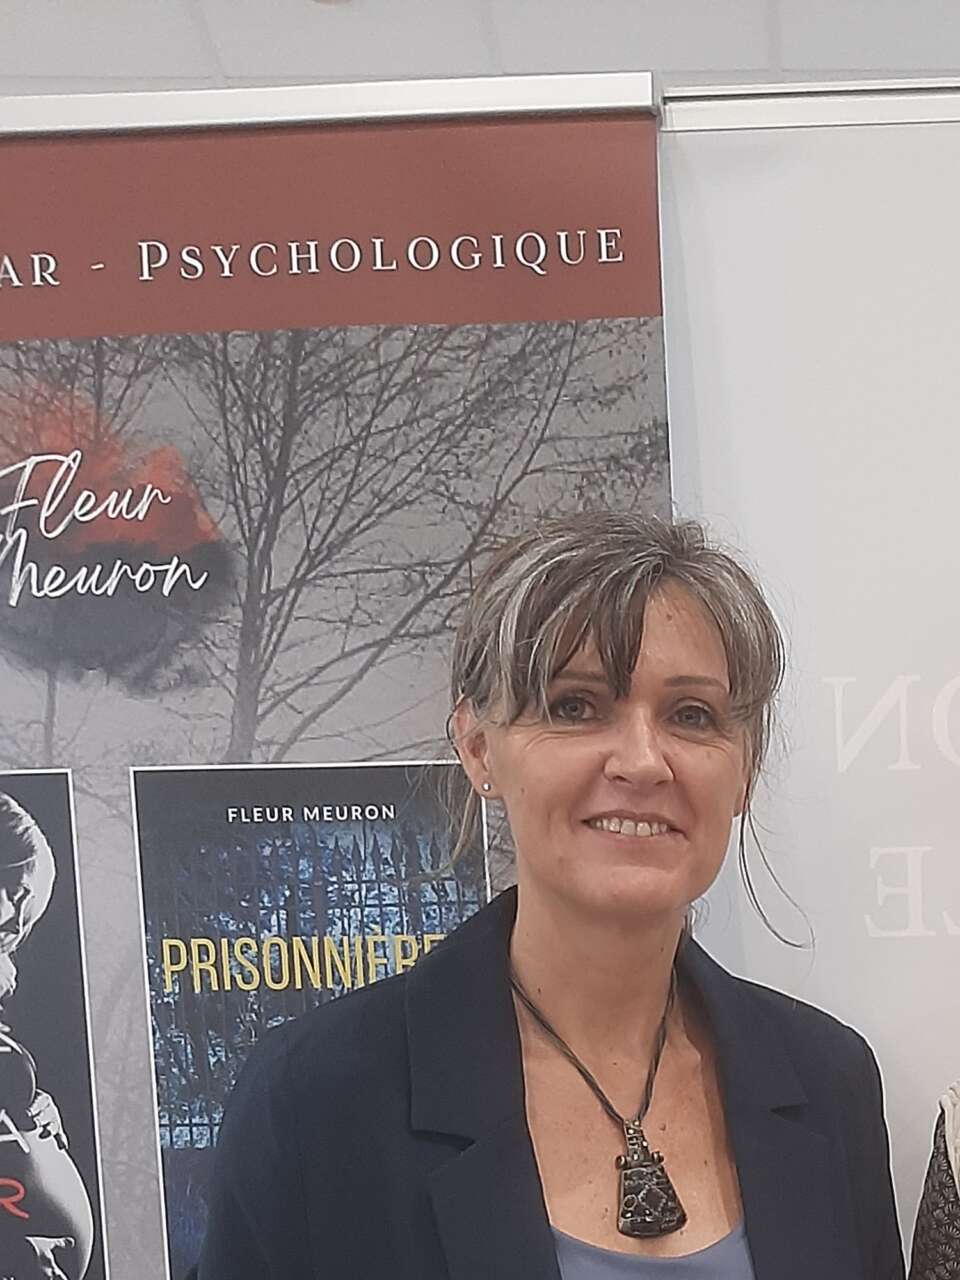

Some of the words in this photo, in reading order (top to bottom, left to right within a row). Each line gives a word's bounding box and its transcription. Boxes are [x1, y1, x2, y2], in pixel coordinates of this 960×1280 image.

[0, 450, 171, 540] Fleur
[227, 807, 294, 823] FLEUR
[303, 804, 395, 822] MEURON
